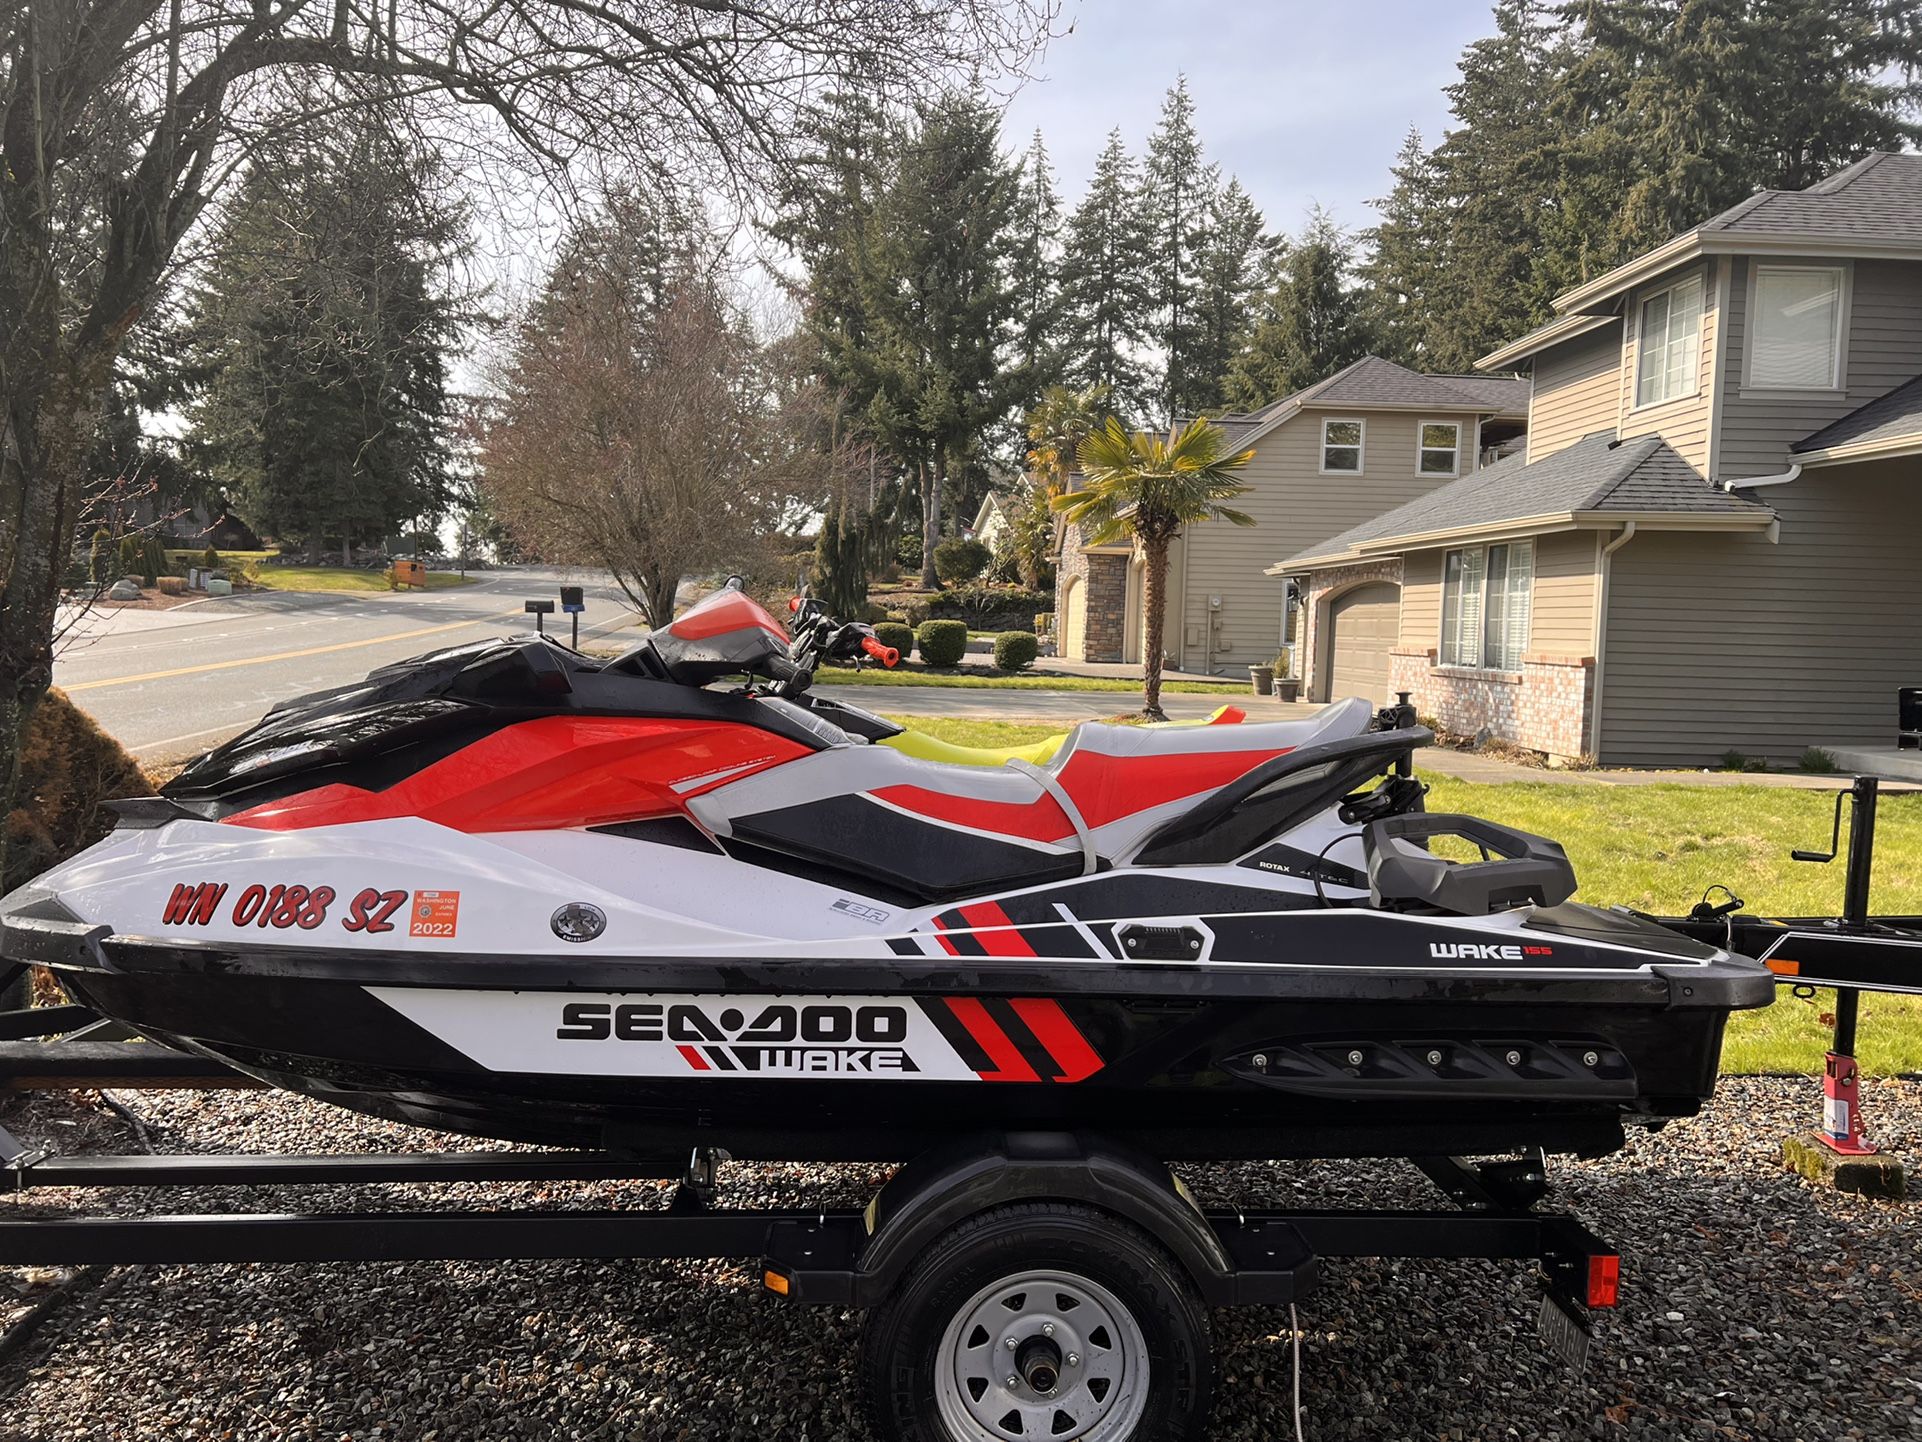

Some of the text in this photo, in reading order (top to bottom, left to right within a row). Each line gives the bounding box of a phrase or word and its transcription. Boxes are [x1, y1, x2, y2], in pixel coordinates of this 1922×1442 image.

[1259, 860, 1291, 873] ROTAX
[162, 882, 408, 934] WN 0188 SZ
[412, 922, 453, 935] 2022
[1429, 943, 1553, 960] WAKE 155
[759, 1049, 904, 1072] WAKE
